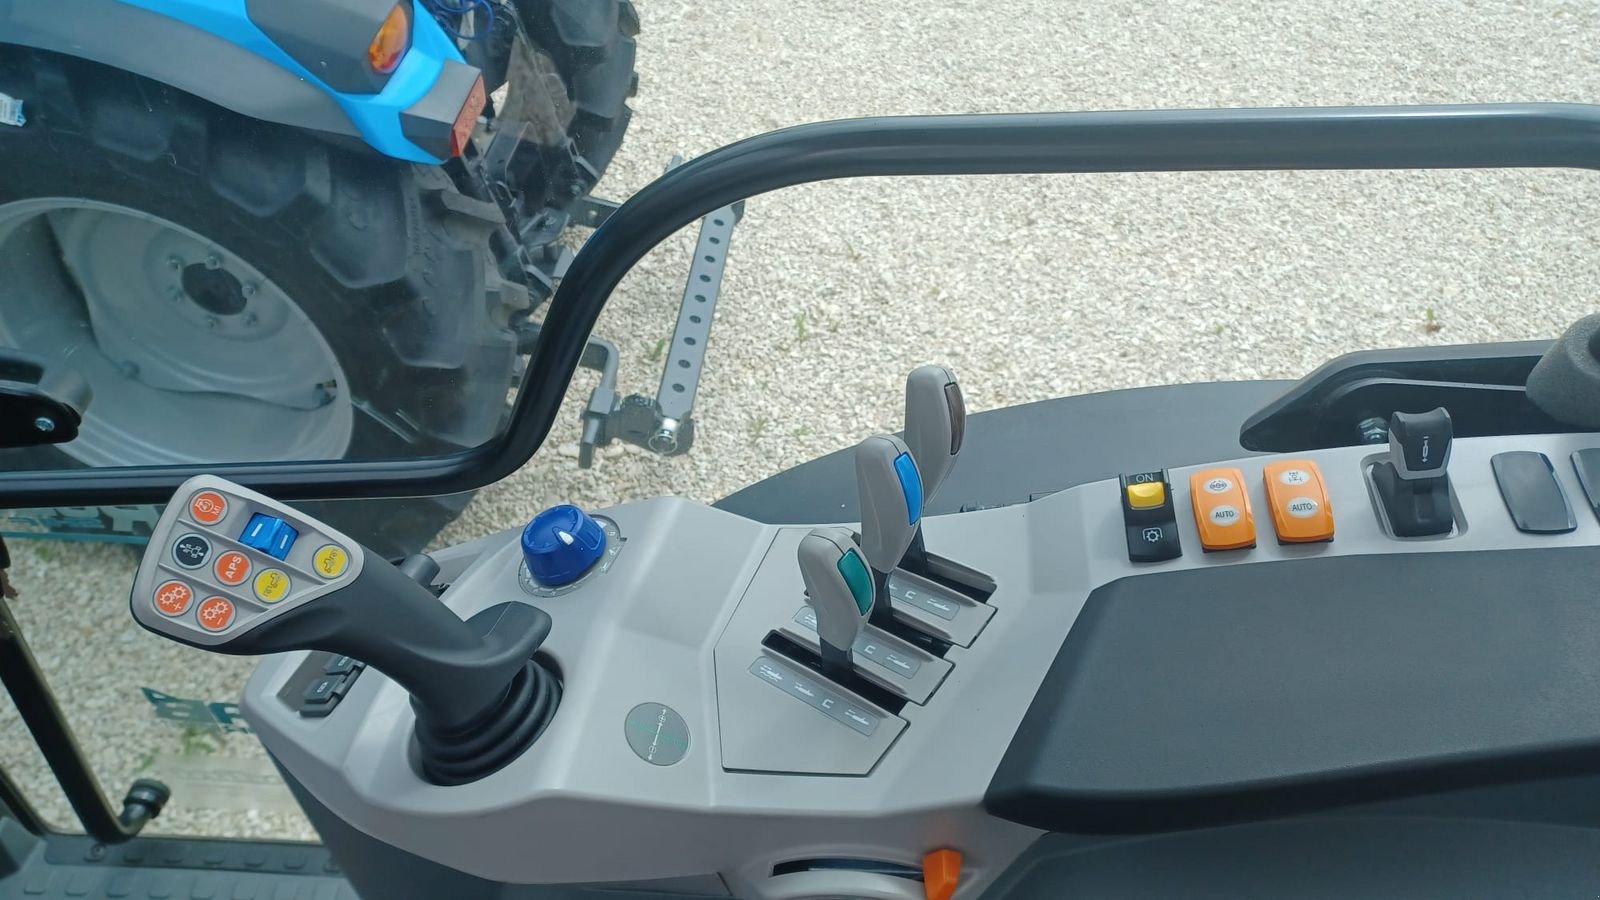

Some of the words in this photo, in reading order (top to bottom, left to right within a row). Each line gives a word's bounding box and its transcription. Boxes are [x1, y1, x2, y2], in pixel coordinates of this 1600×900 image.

[1136, 473, 1154, 482] ON
[1292, 502, 1312, 512] AUTO
[1215, 510, 1234, 519] AUTO
[225, 555, 242, 579] APS
